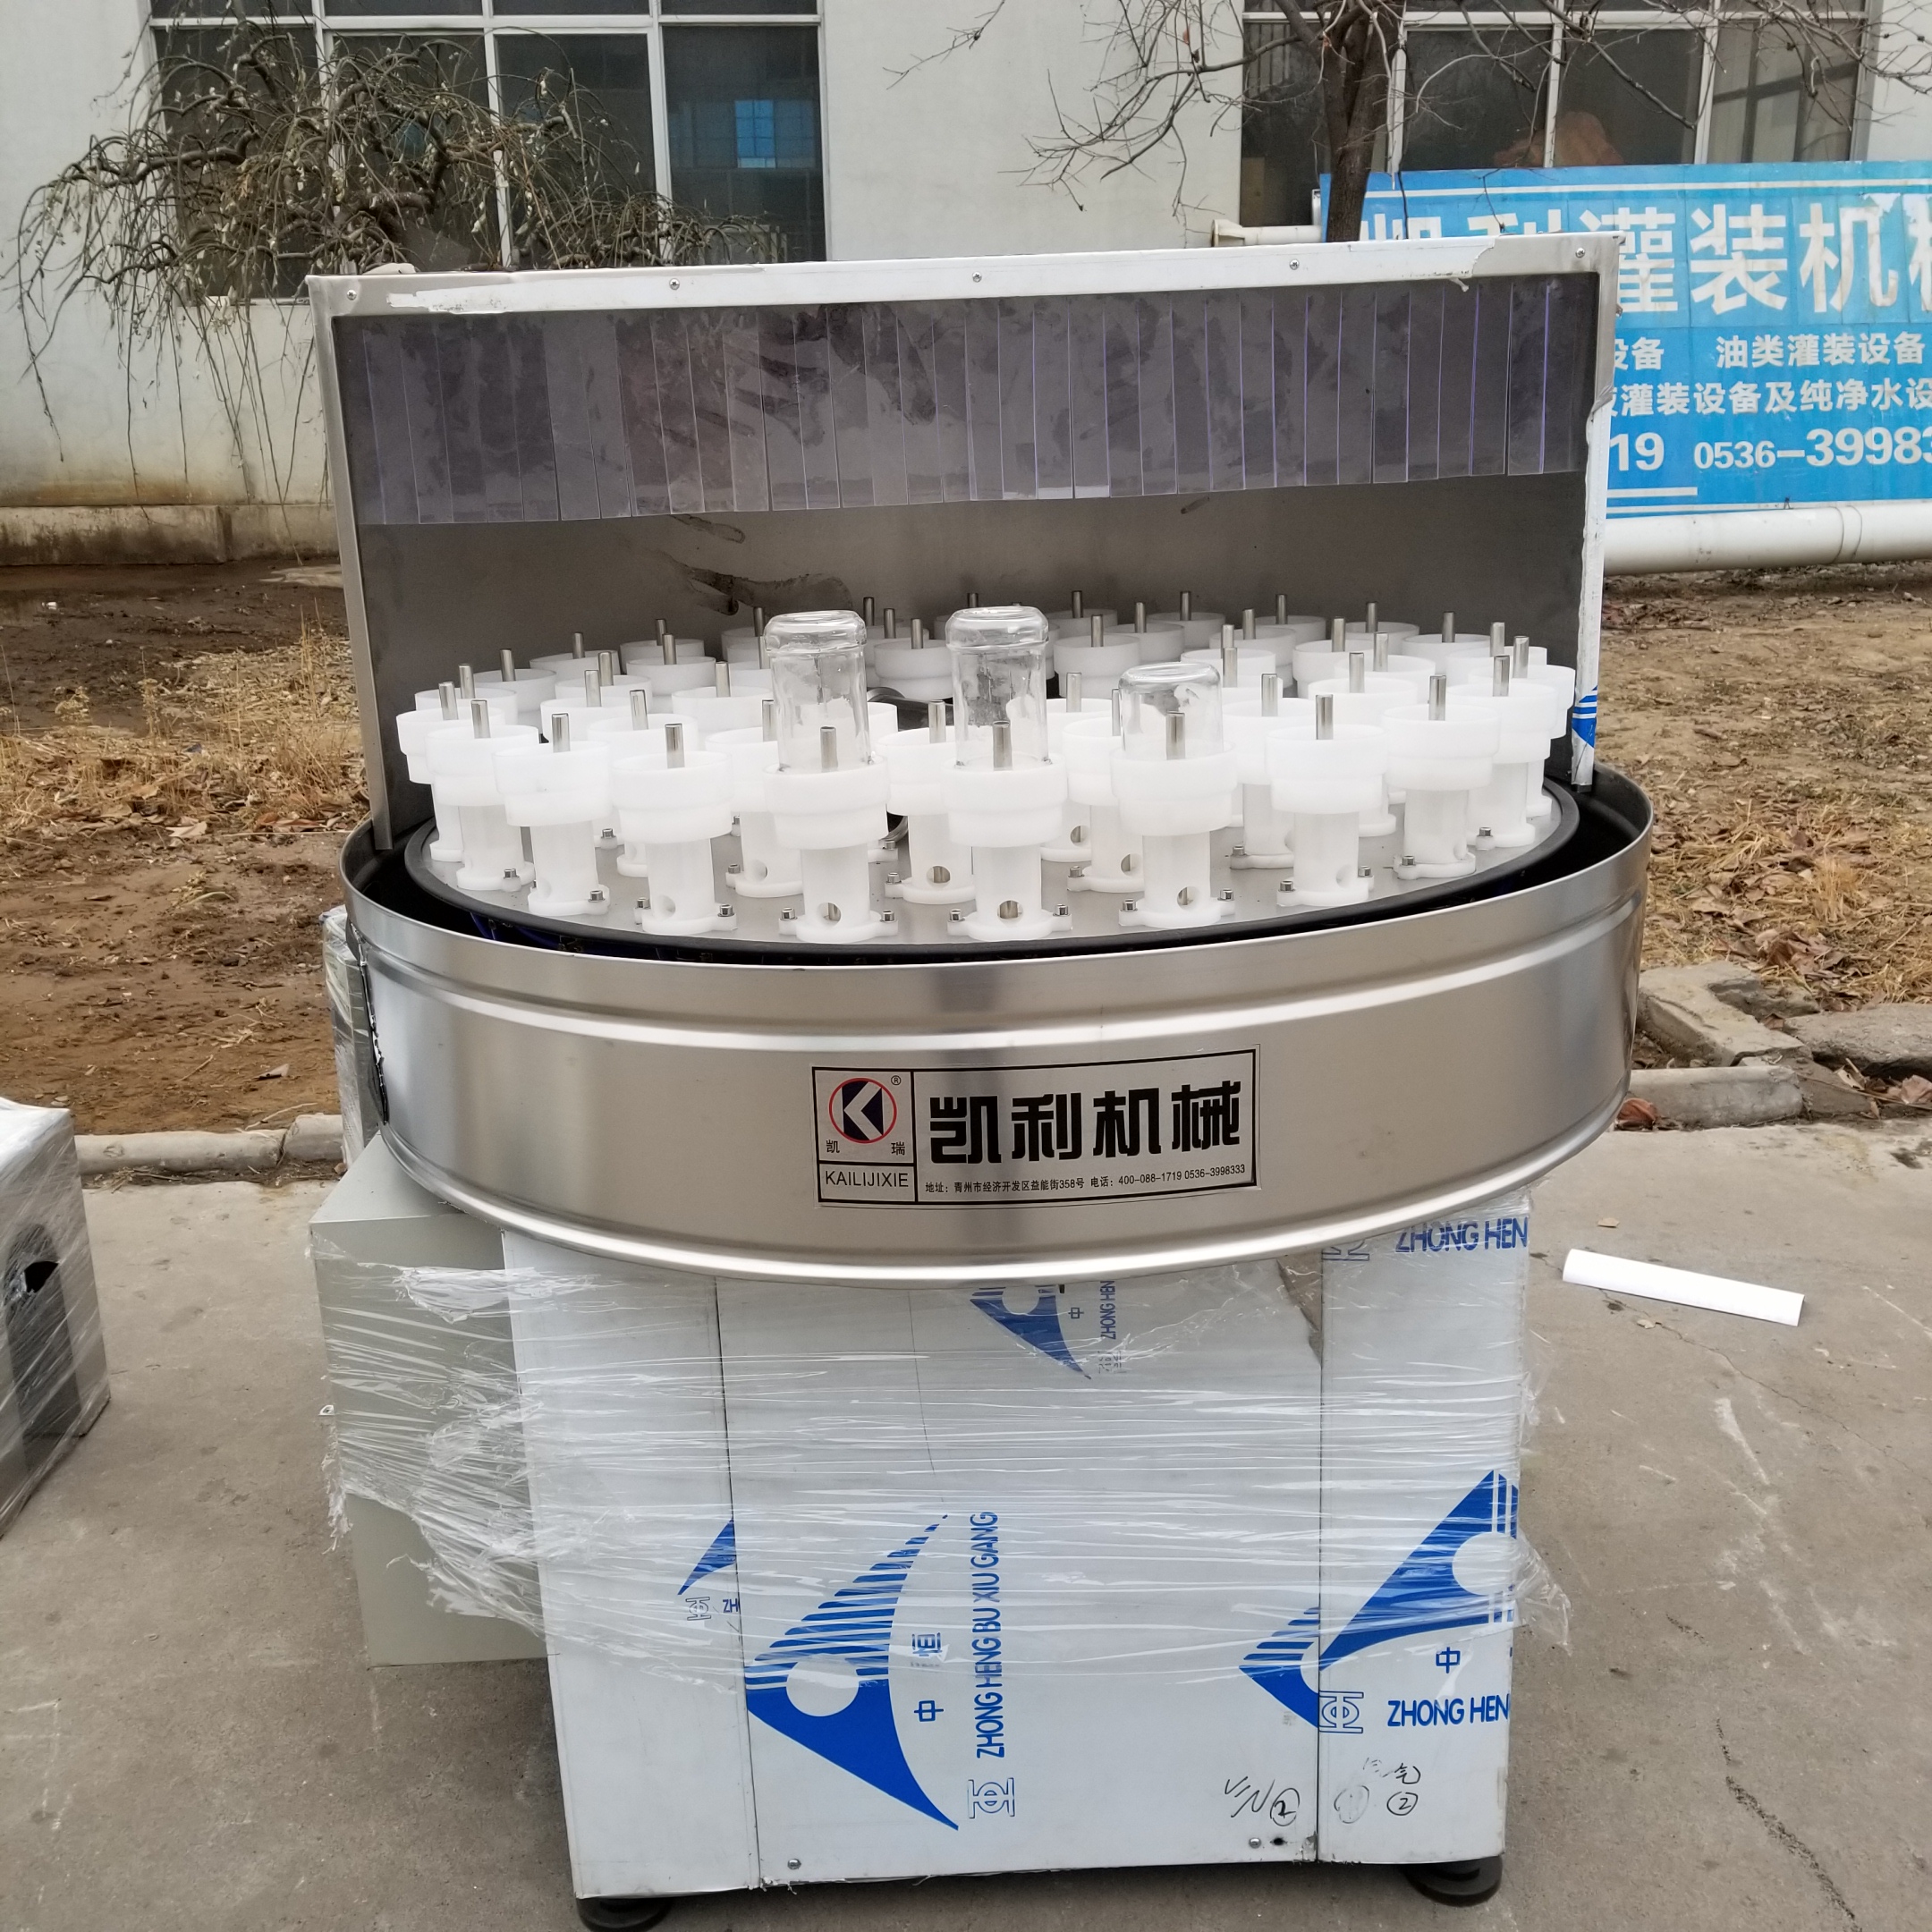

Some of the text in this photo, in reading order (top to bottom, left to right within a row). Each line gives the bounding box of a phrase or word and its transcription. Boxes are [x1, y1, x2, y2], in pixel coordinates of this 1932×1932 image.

[1360, 202, 1932, 314] 灌装机
[1716, 331, 1925, 369] 油类灌装设备
[1612, 377, 1932, 417] 灌装设备及纯净水设
[929, 1080, 1242, 1165] 凯利机械
[826, 1140, 905, 1156] 凯 瑞
[825, 1170, 909, 1188] KAILIJIXIE
[1184, 1164, 1245, 1180] 0536-3998333
[1394, 1221, 1479, 1253] ZHONG
[1099, 1303, 1116, 1340] ZHONG
[970, 1512, 1005, 1759] ZHONG HENG BU XIU GANG
[1436, 1647, 1461, 1674] 中
[1387, 1699, 1465, 1727] ZHONG
